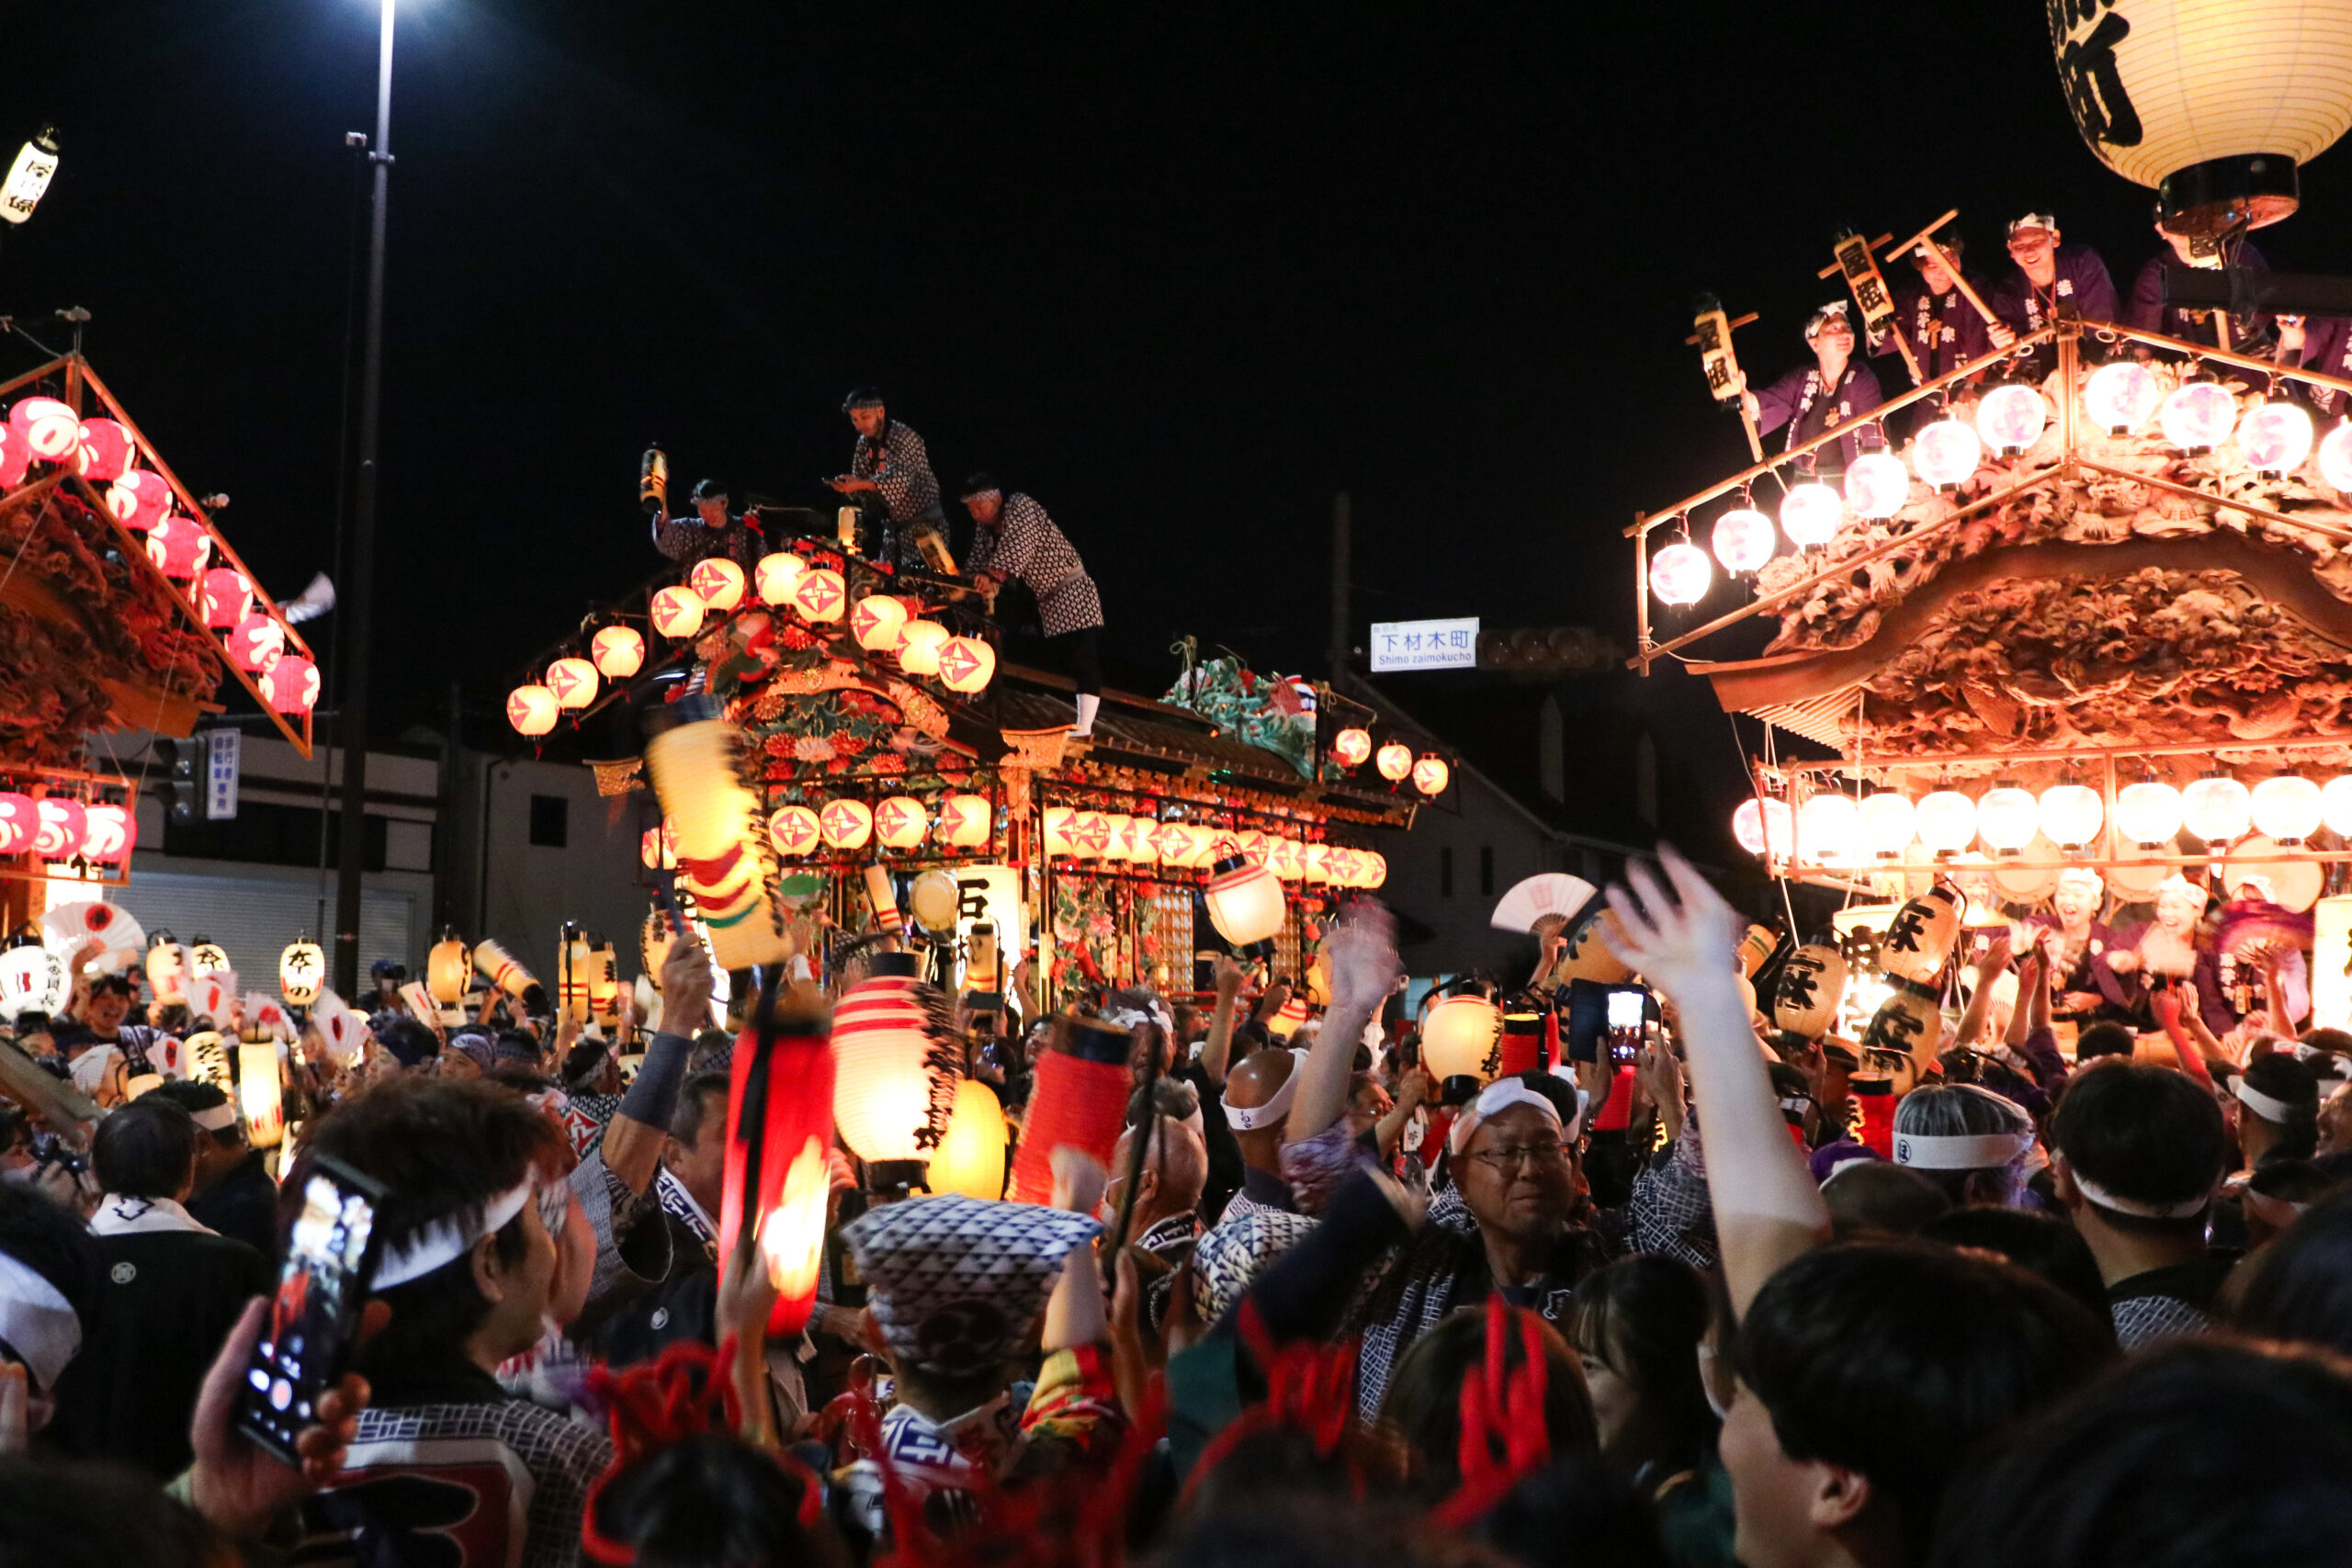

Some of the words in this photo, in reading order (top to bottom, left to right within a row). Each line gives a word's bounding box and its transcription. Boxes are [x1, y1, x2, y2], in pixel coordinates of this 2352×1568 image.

[1381, 630, 1470, 652] 下材木町
[1379, 654, 1410, 666] Shimo
[1412, 651, 1472, 664] zaimokucho
